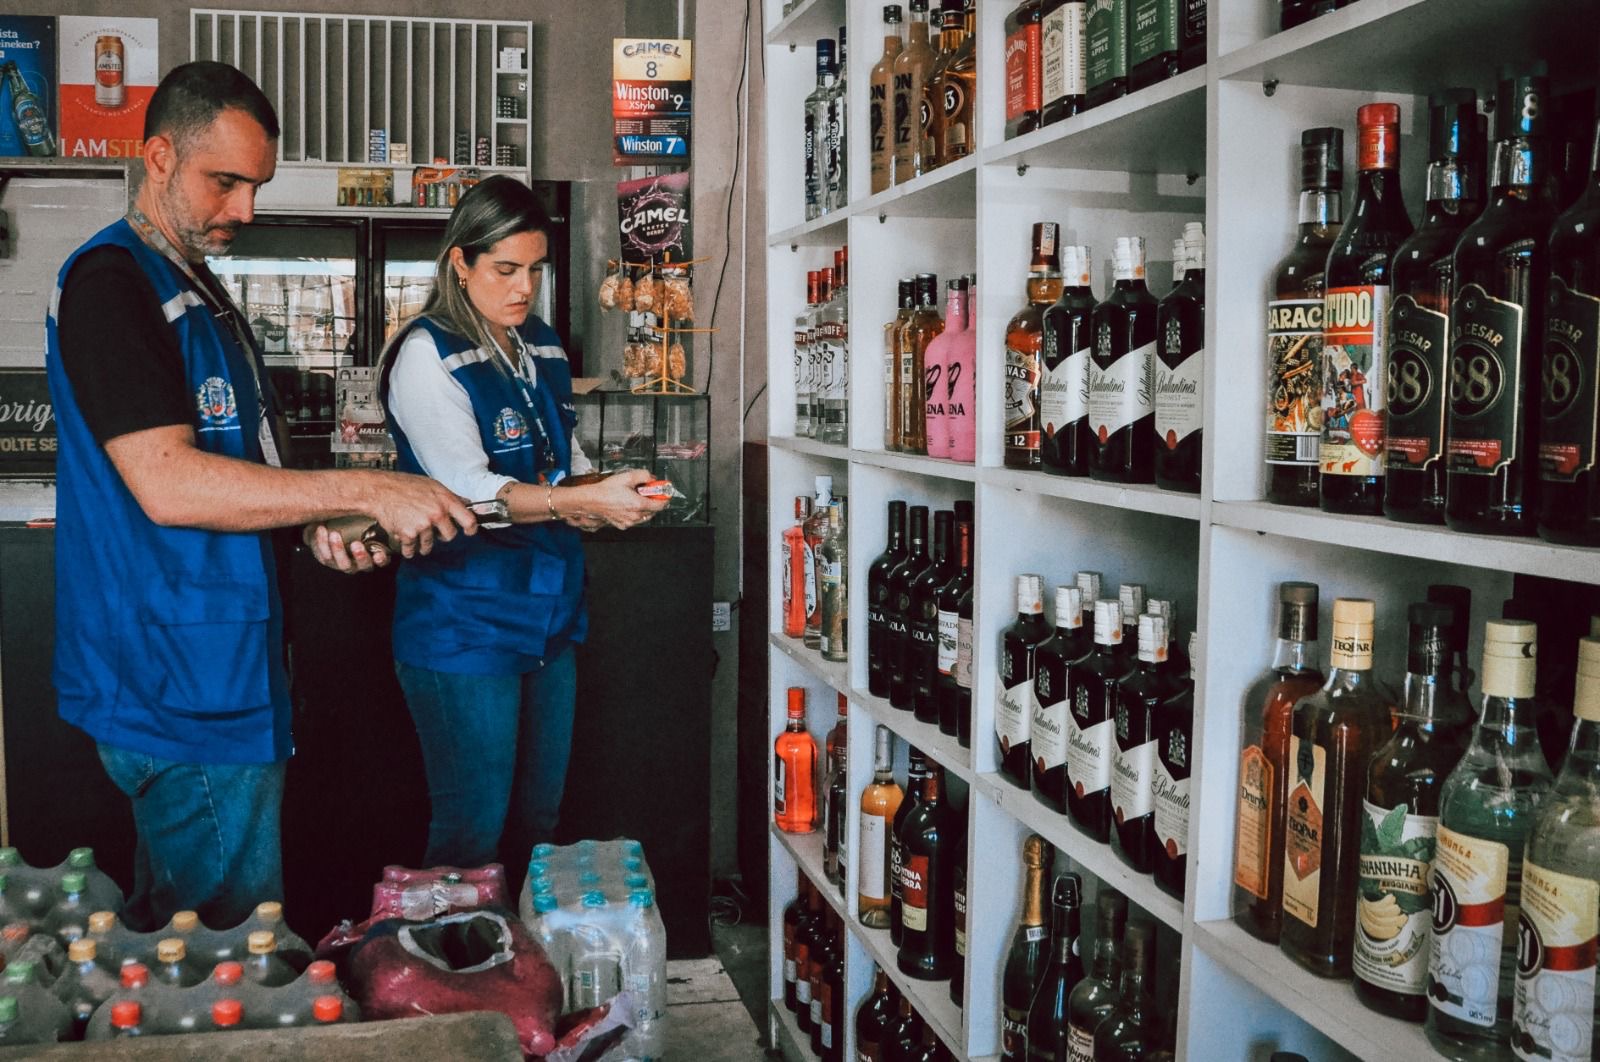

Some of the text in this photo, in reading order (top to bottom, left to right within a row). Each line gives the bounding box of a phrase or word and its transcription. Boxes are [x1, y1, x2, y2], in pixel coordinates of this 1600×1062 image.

[1136, 15, 1157, 31] APPLE
[622, 42, 682, 58] CAMEL
[1091, 43, 1108, 57] APPLE
[646, 61, 657, 78] 8
[616, 81, 684, 111] Winston 9
[628, 100, 656, 112] XStyle
[61, 138, 66, 157] I
[622, 136, 677, 154] Winston 7
[620, 207, 689, 234] CAMEL
[1327, 291, 1371, 328] TUDO
[1398, 330, 1432, 352] CESAR
[1464, 322, 1504, 348] CESAR
[1549, 318, 1584, 343] CESAR
[1090, 370, 1126, 392] Ballantine's
[1137, 353, 1152, 406] Ballantine's
[1156, 370, 1198, 395] Ballantine's
[1450, 356, 1492, 402] 88
[0, 437, 36, 452] OLTE
[1014, 435, 1026, 446] 12
[1032, 704, 1061, 735] Ballantine's
[1068, 724, 1102, 758] Ballantine's
[1241, 786, 1267, 810] Drury's
[1289, 816, 1319, 841] TEQPAR
